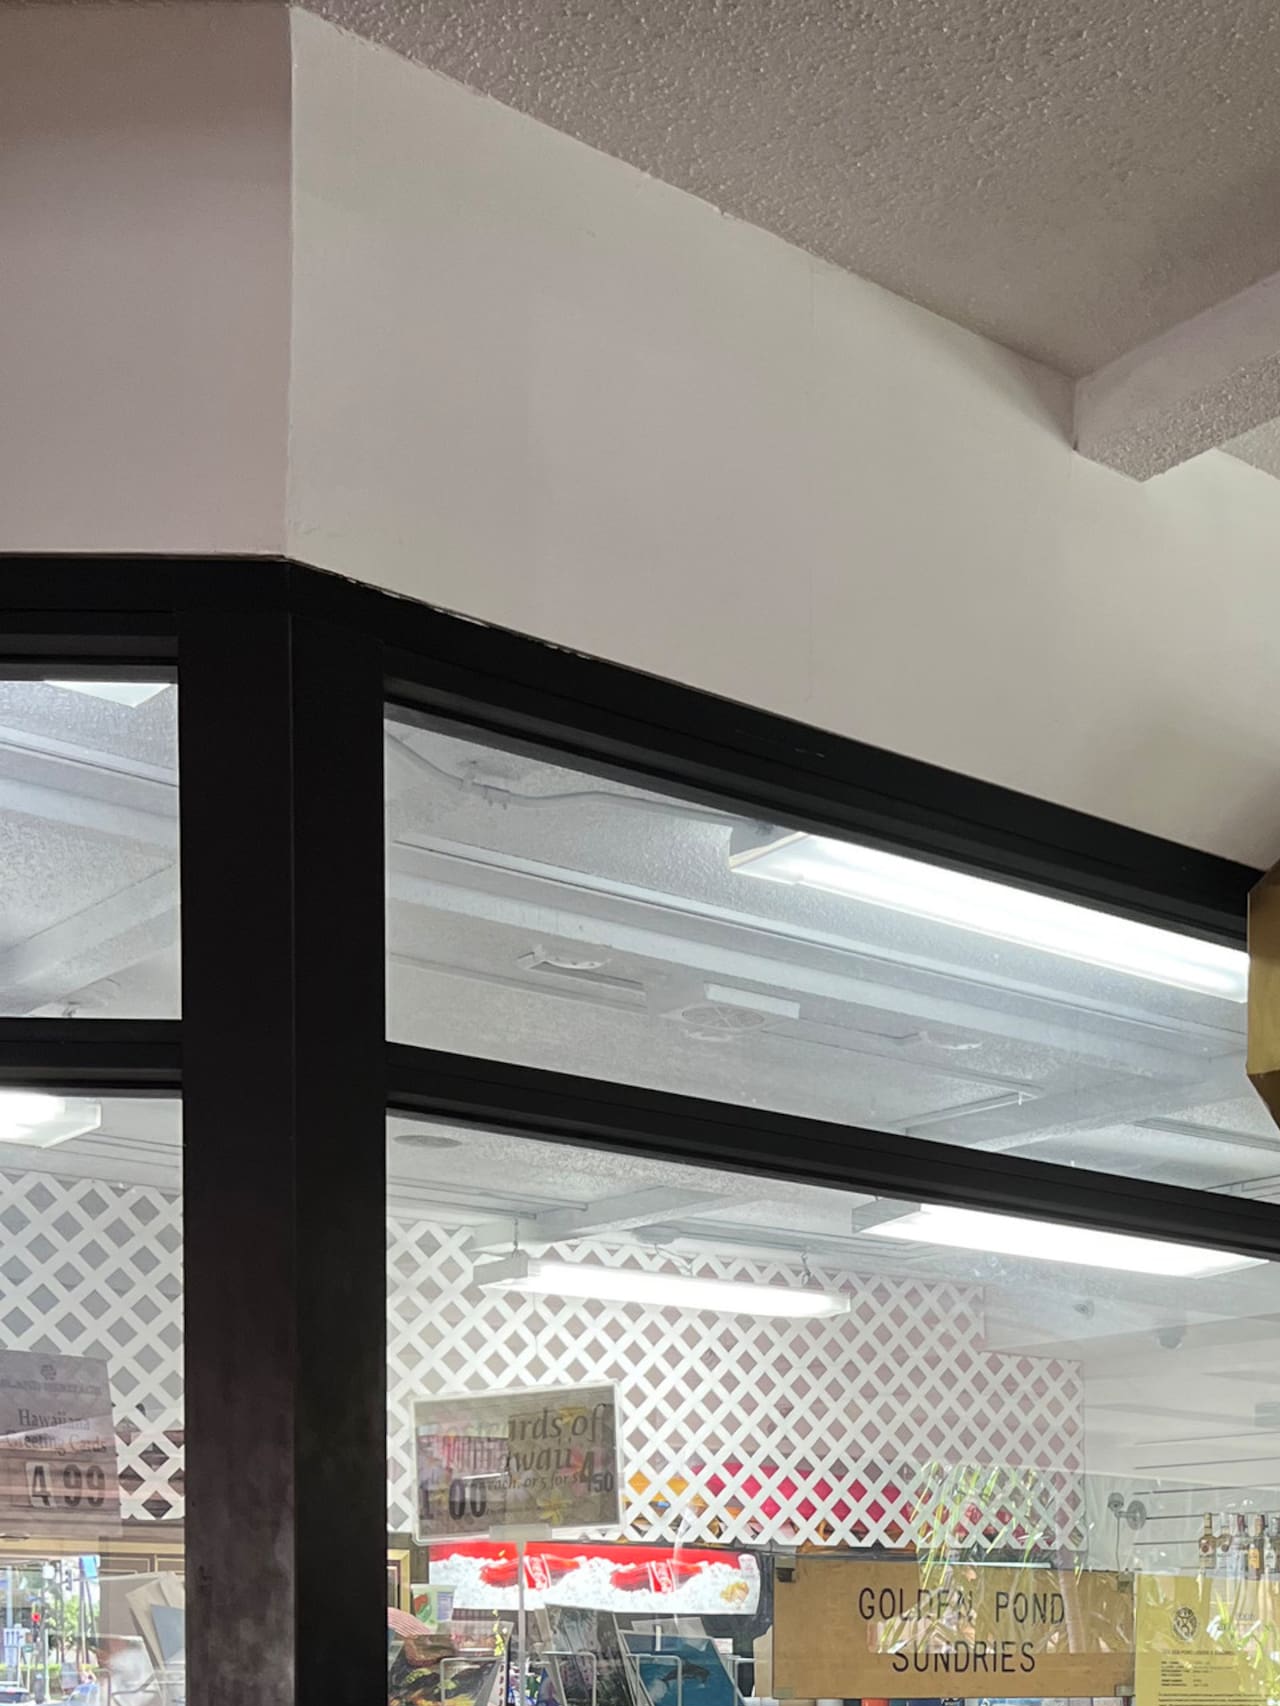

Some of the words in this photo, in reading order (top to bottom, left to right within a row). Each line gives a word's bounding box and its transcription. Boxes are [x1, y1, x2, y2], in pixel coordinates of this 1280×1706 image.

[858, 1586, 974, 1623] GOLDEN
[995, 1590, 1066, 1625] POND
[891, 1640, 1036, 1673] SUNDRIES
